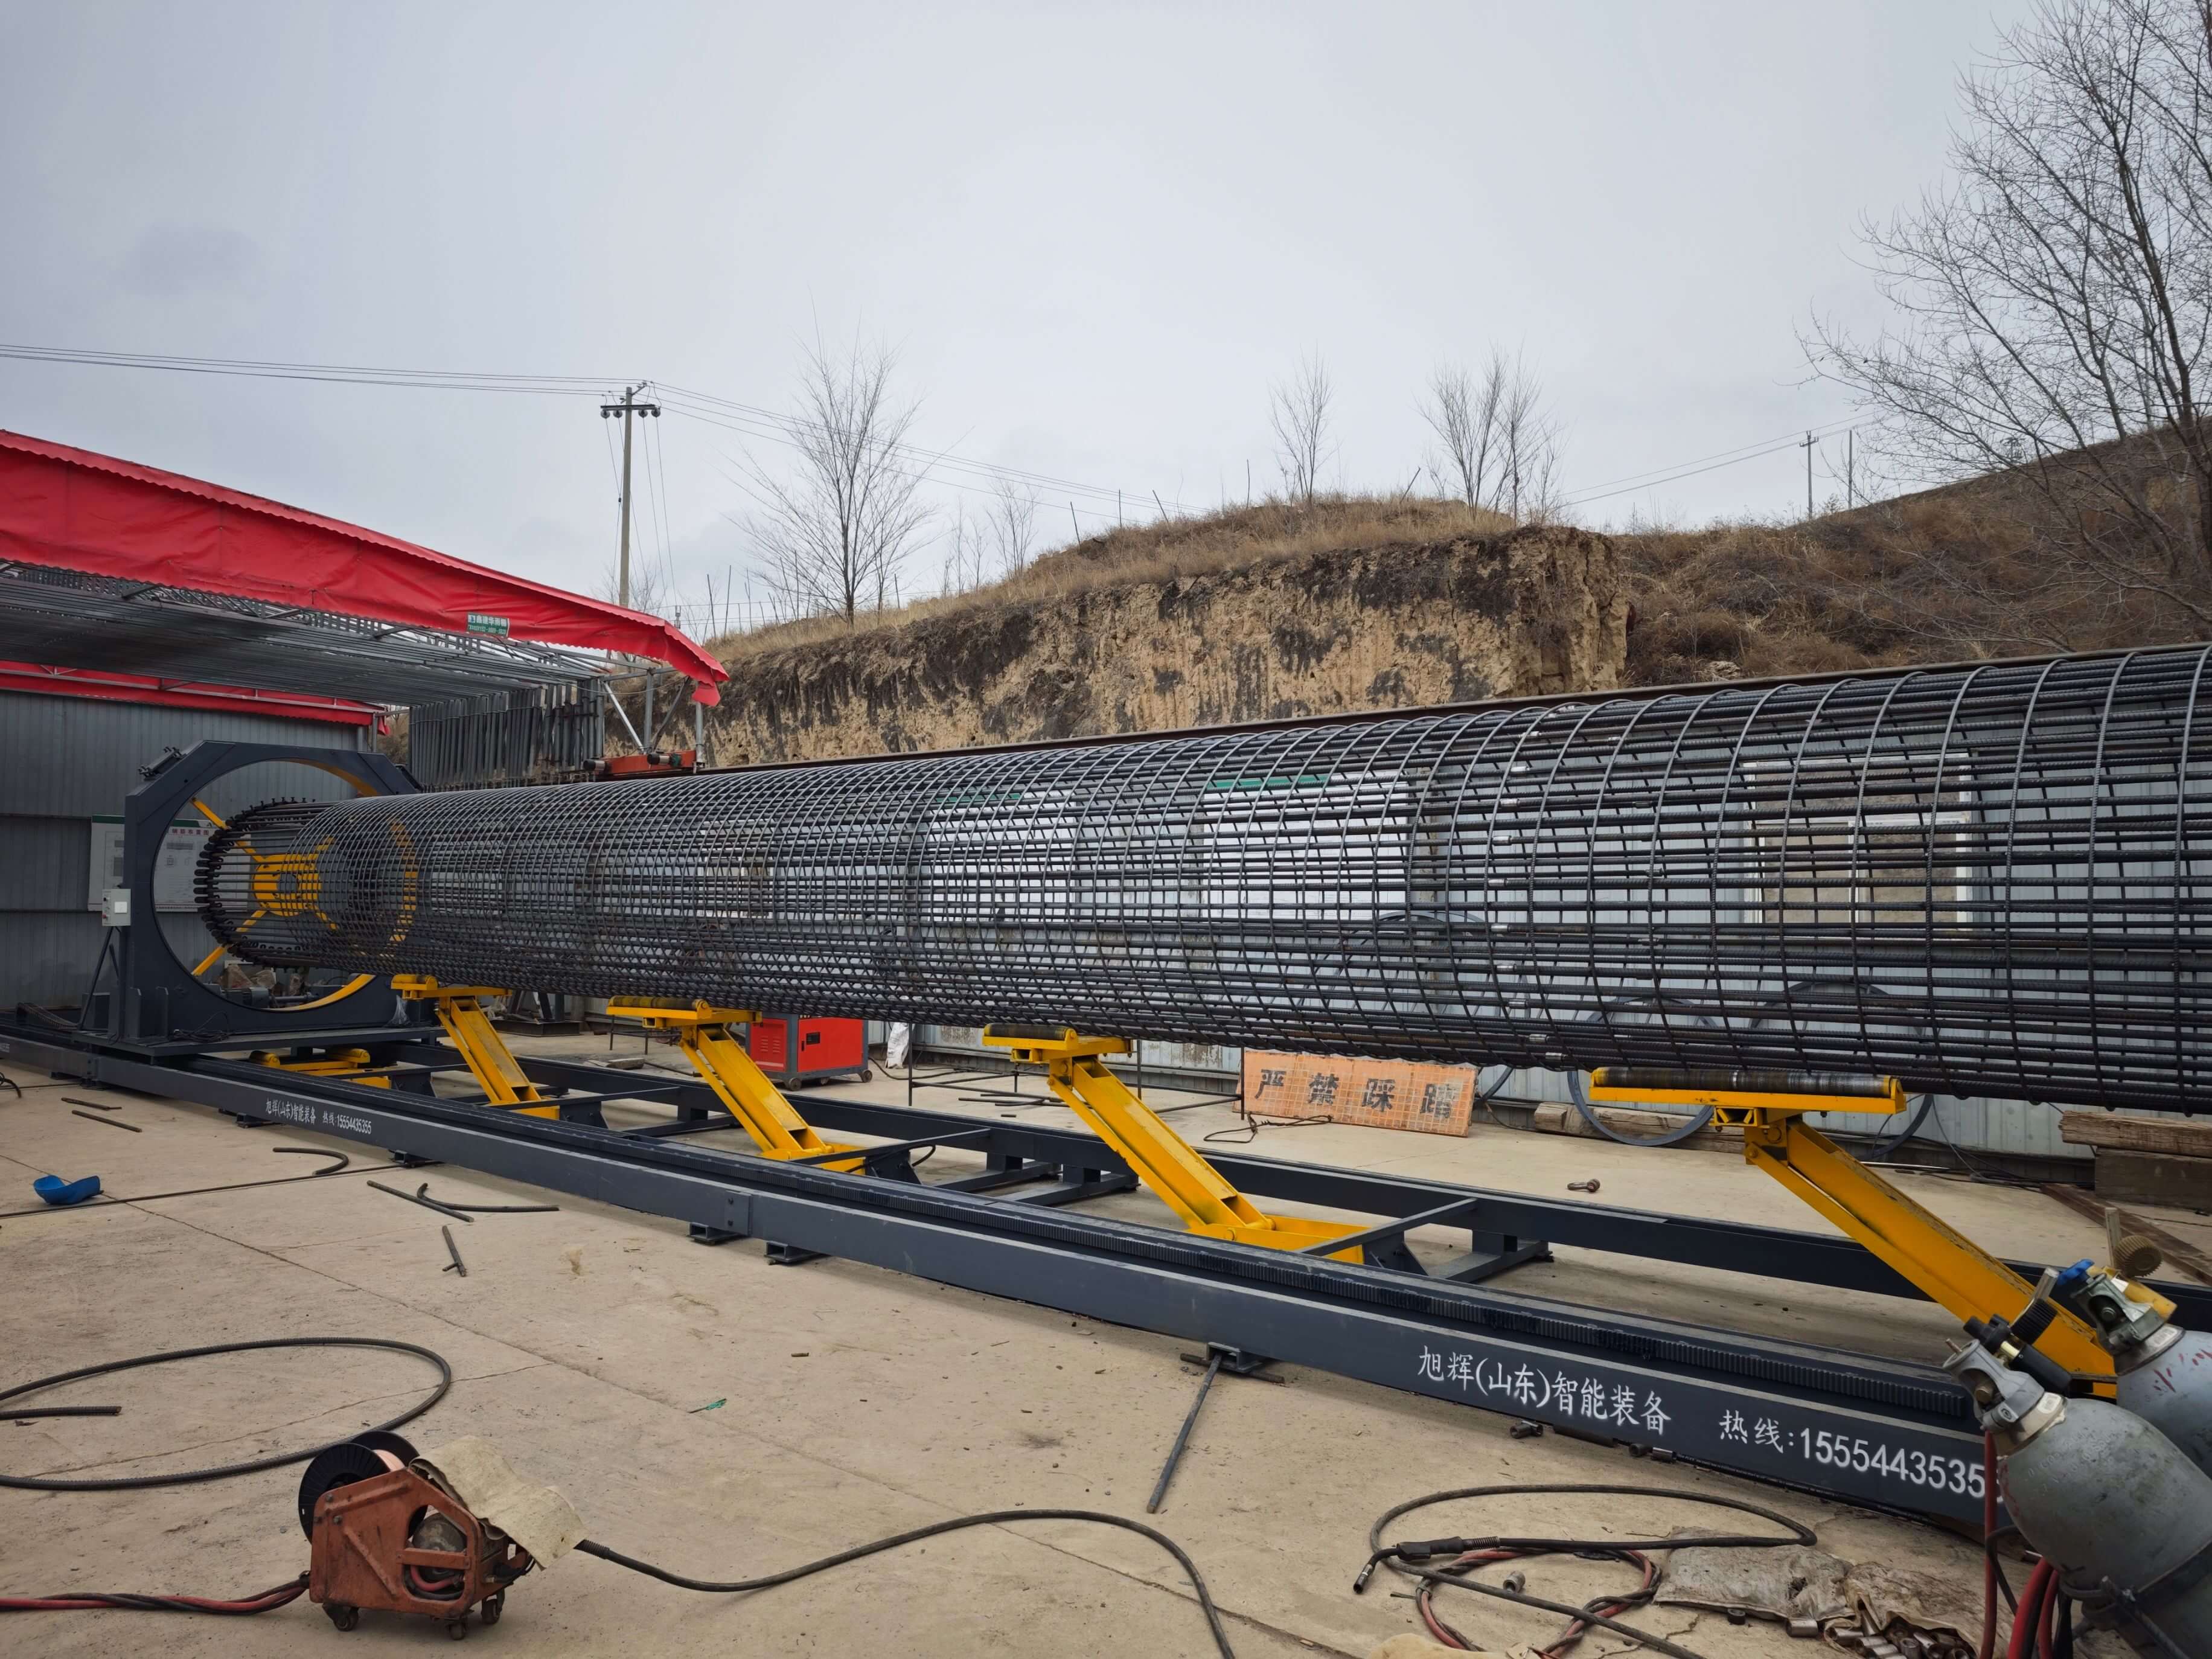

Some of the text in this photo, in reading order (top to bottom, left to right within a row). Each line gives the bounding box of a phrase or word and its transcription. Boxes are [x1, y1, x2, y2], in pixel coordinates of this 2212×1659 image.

[1418, 1345, 1672, 1436] 旭辉(山东)智能装备
[1718, 1409, 2003, 1503] 热线:1555443535
